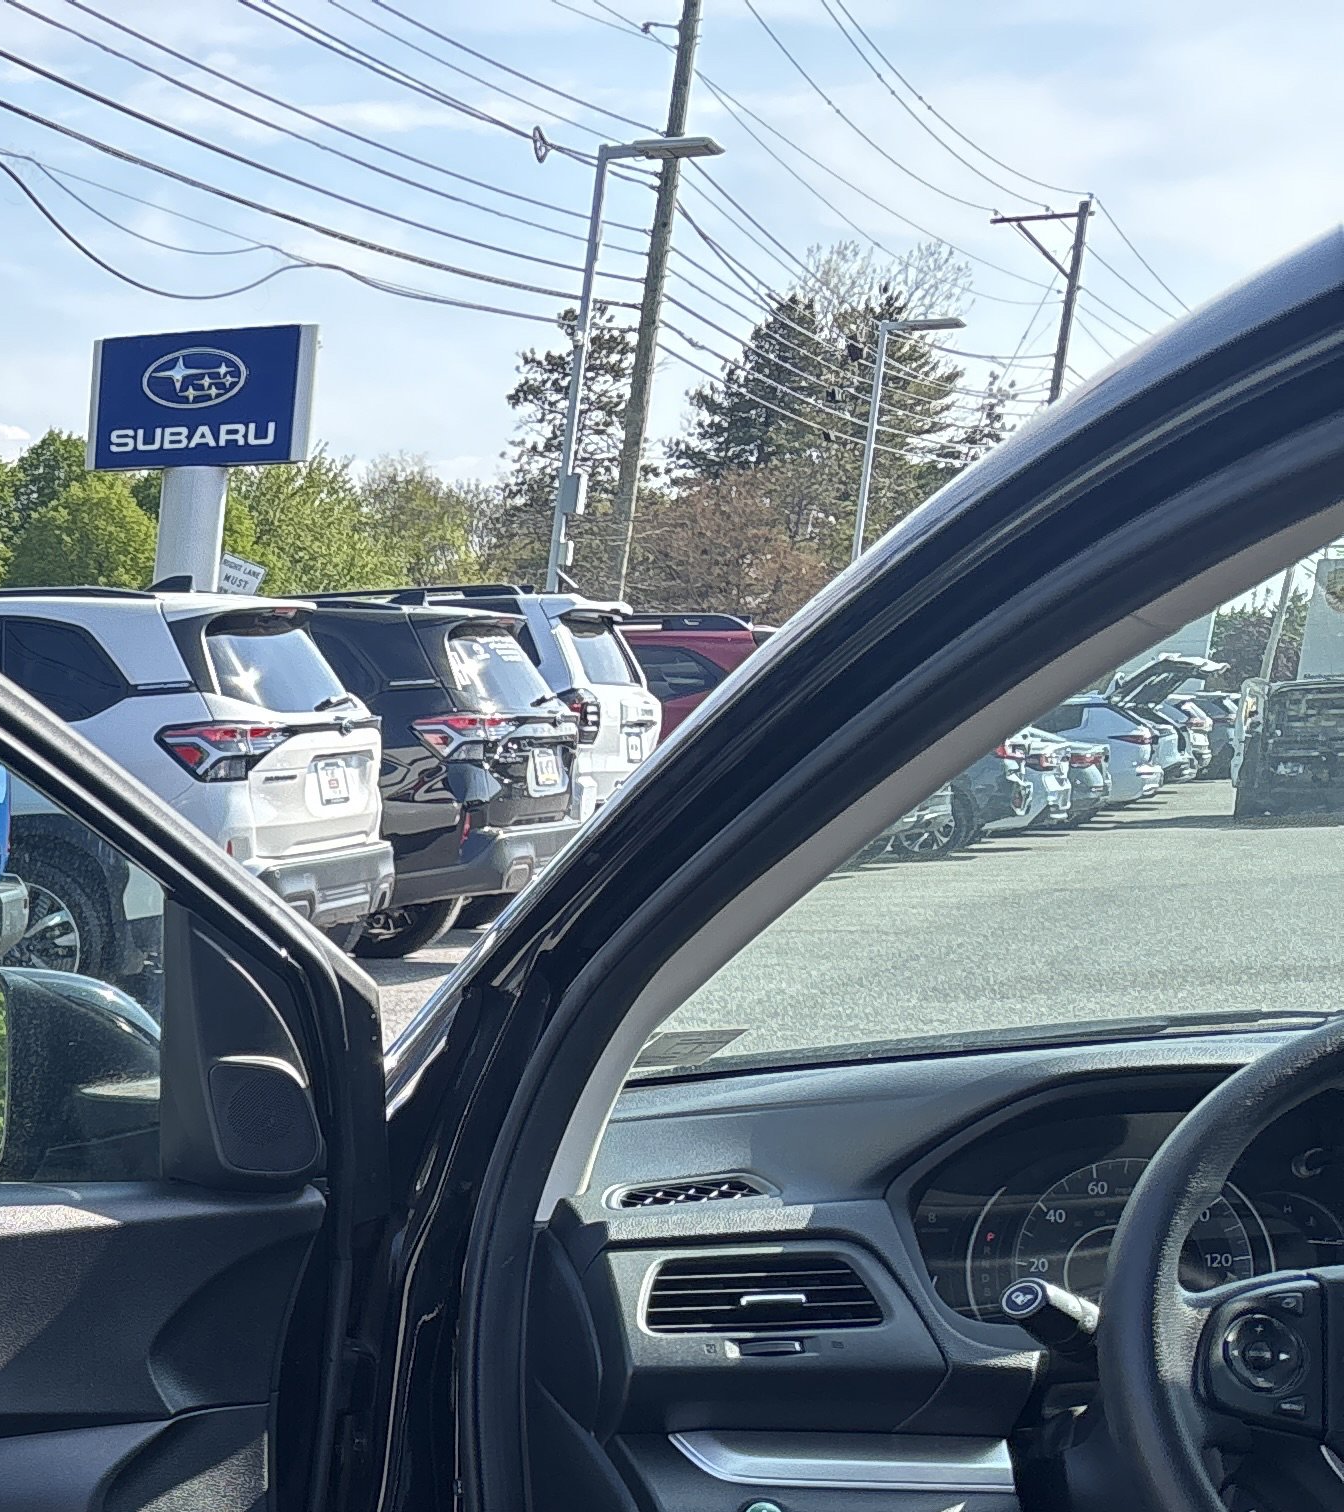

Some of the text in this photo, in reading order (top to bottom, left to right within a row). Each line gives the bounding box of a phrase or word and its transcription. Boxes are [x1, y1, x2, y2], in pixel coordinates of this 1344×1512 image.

[109, 421, 276, 452] SUBARU
[223, 573, 250, 591] MUST
[1087, 1181, 1108, 1195] 60
[1045, 1208, 1067, 1223] 40
[986, 1231, 996, 1242] P
[1029, 1257, 1050, 1273] 20
[1204, 1252, 1233, 1268] 120
